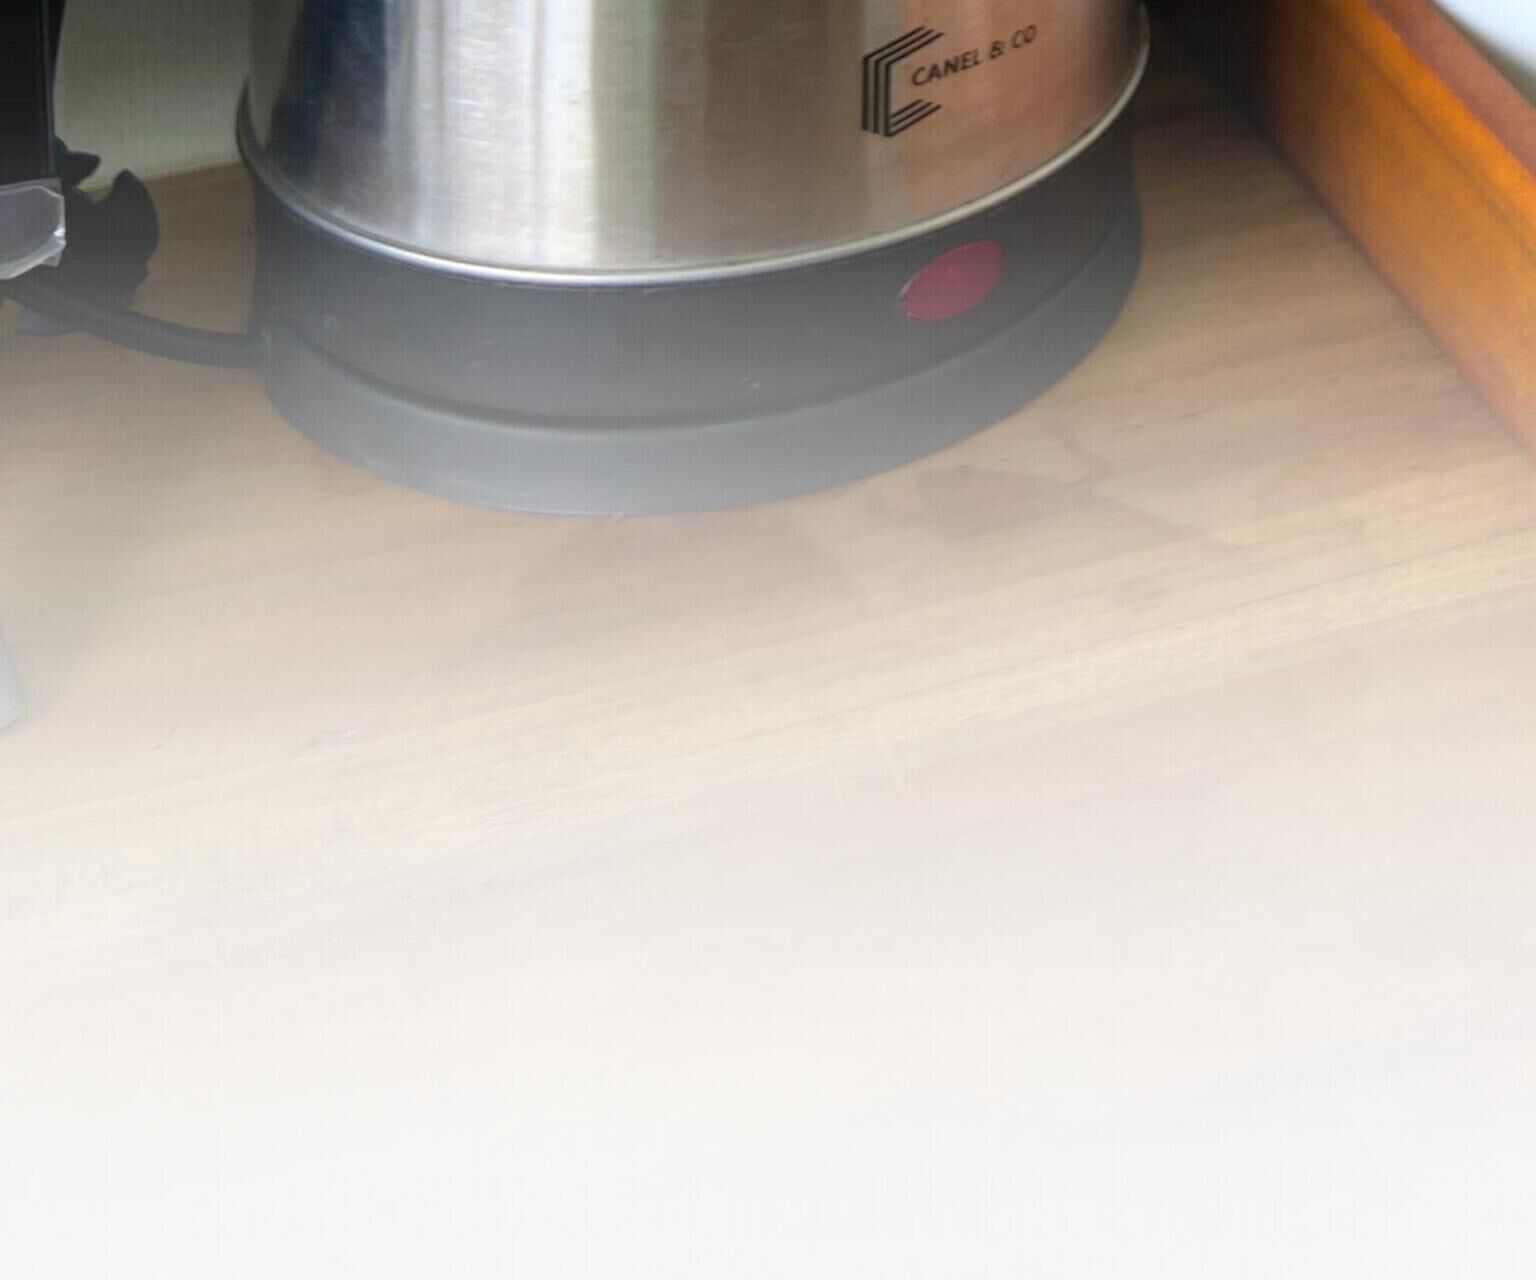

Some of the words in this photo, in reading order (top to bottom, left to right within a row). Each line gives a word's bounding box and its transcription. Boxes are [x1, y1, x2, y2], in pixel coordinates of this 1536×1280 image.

[911, 48, 982, 87] CANEL
[988, 40, 1006, 60] &
[1010, 24, 1038, 49] CO
